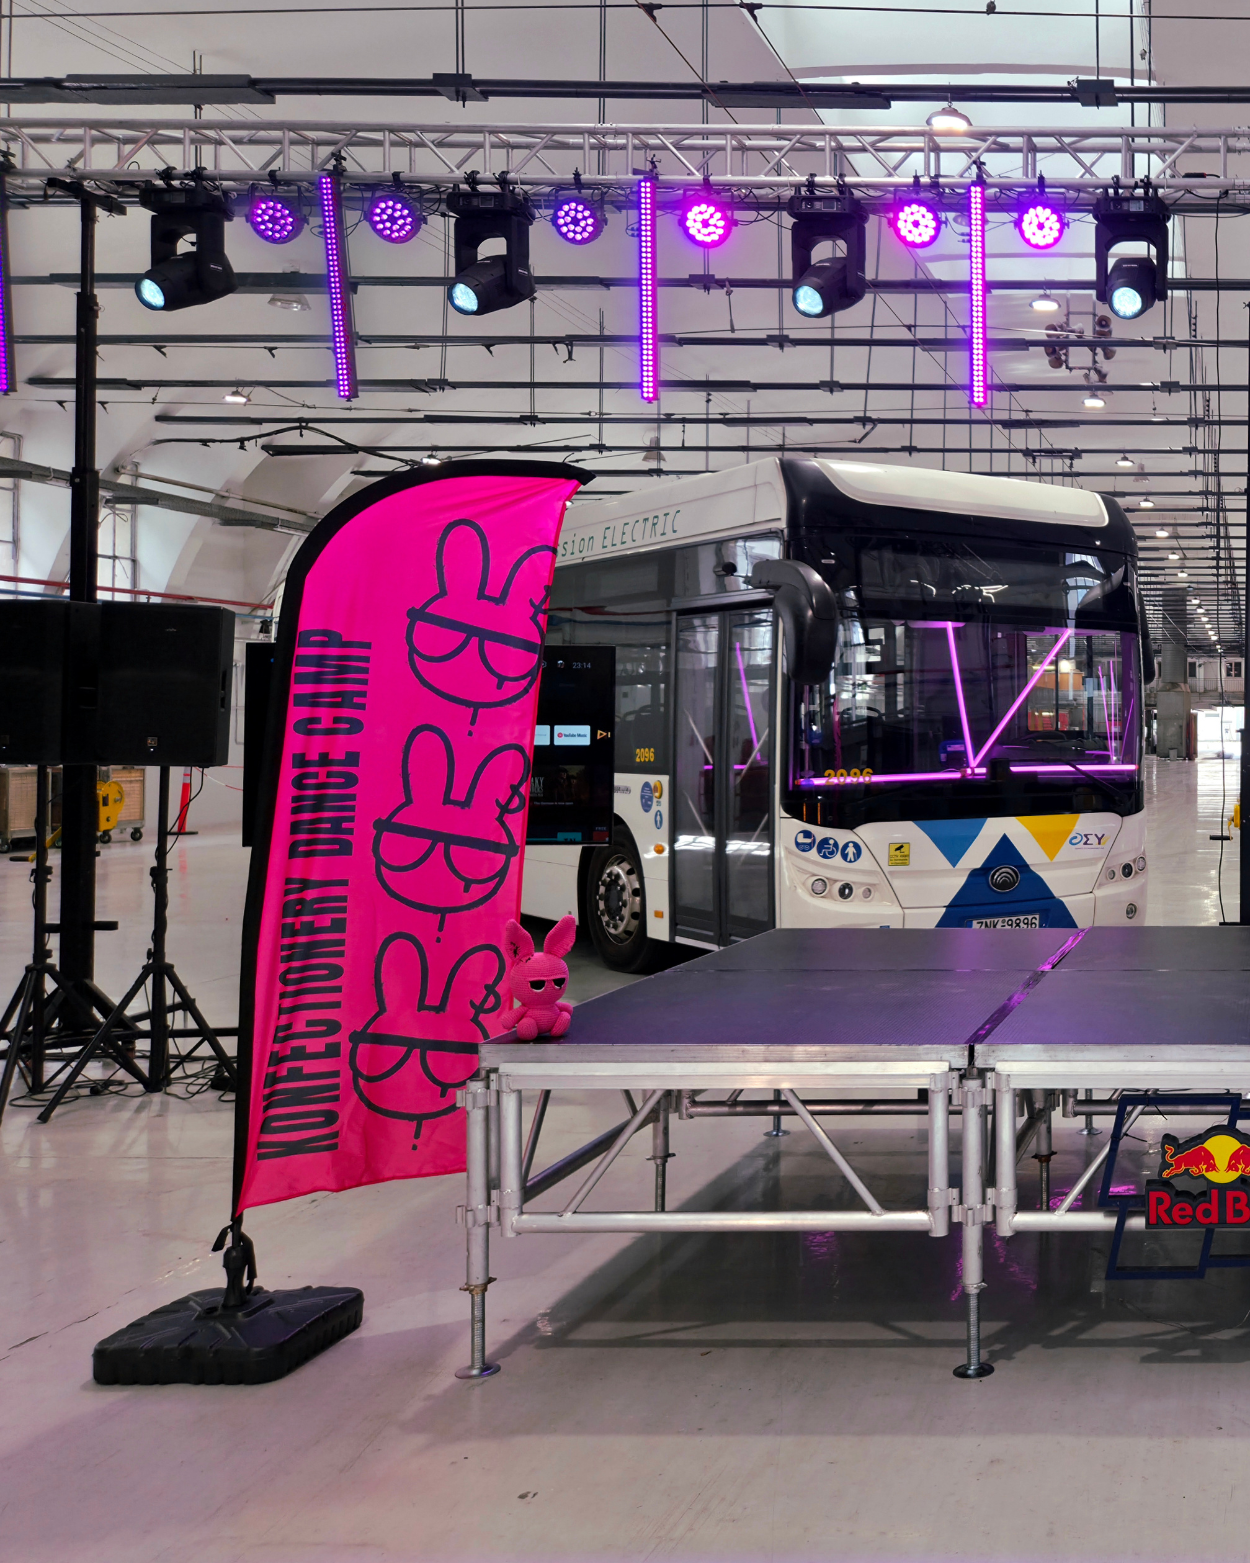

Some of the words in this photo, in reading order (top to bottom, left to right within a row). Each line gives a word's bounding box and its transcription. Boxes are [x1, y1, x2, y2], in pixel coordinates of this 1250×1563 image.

[556, 533, 595, 558] sion
[602, 509, 681, 550] ELECTRIC
[292, 628, 372, 736] CAMP
[635, 747, 655, 762] 2096
[531, 776, 545, 788] AKY
[823, 767, 874, 786] 2096
[288, 751, 361, 860] DANCE
[256, 877, 350, 1162] KONFECTIONERY
[1148, 1188, 1219, 1225] Red
